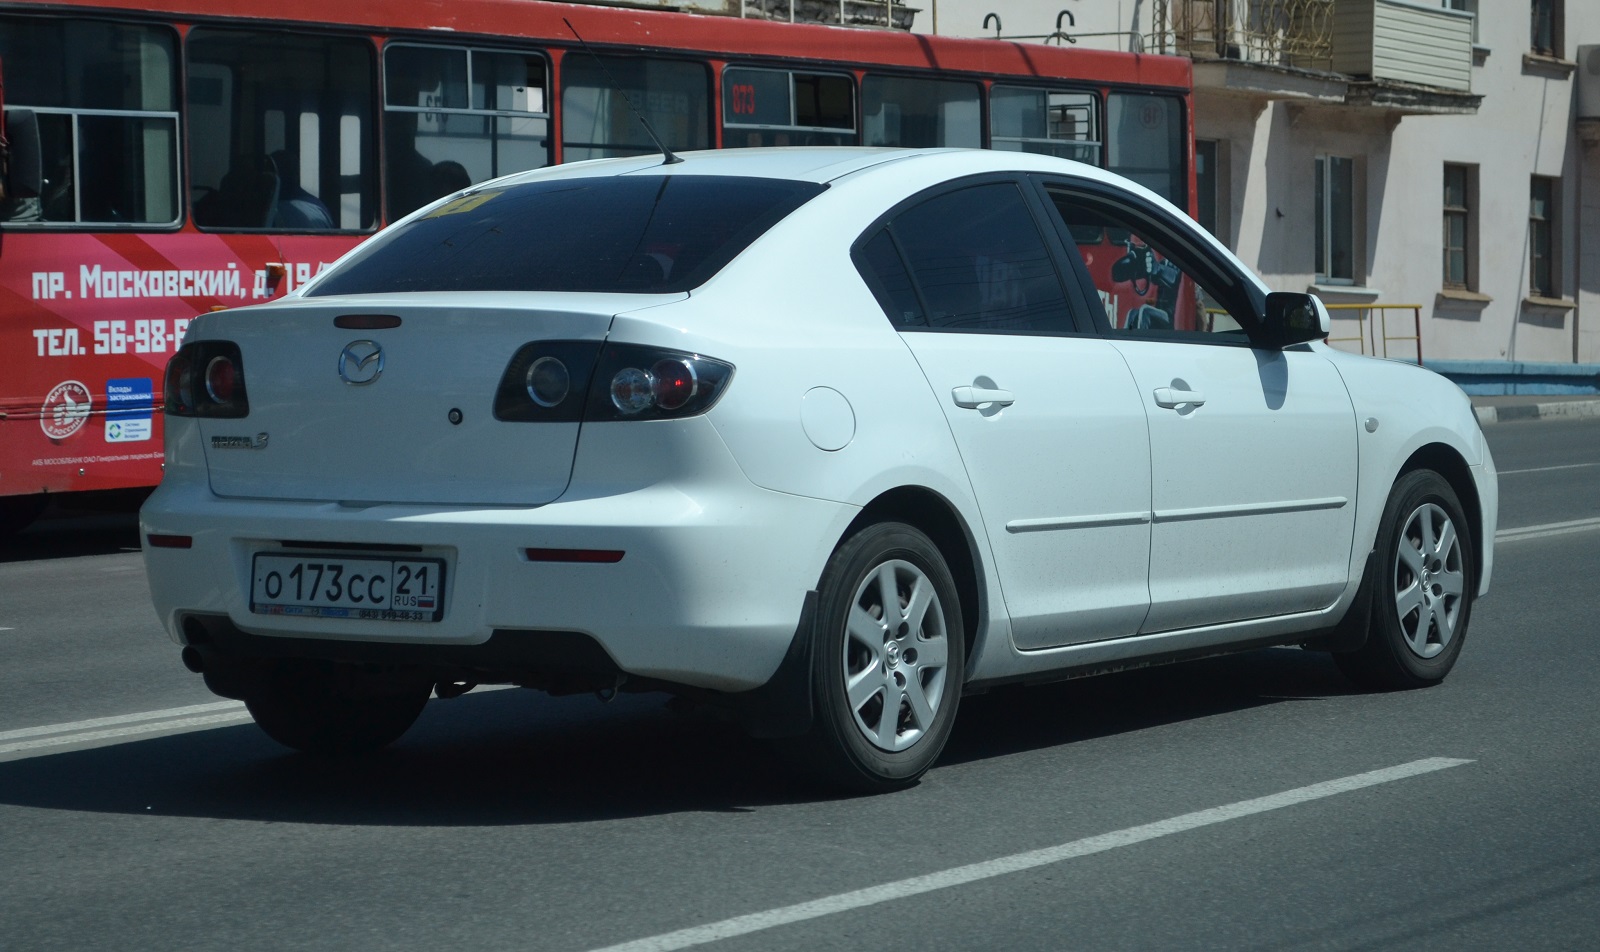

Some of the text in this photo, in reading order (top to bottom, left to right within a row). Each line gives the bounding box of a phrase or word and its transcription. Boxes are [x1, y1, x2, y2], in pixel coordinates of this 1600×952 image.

[732, 83, 755, 115] 873
[49, 384, 72, 403] МАРКА
[108, 385, 132, 394] Вклады
[109, 393, 152, 402] застрахованы
[397, 565, 428, 595] 21
[394, 595, 417, 607] RUS
